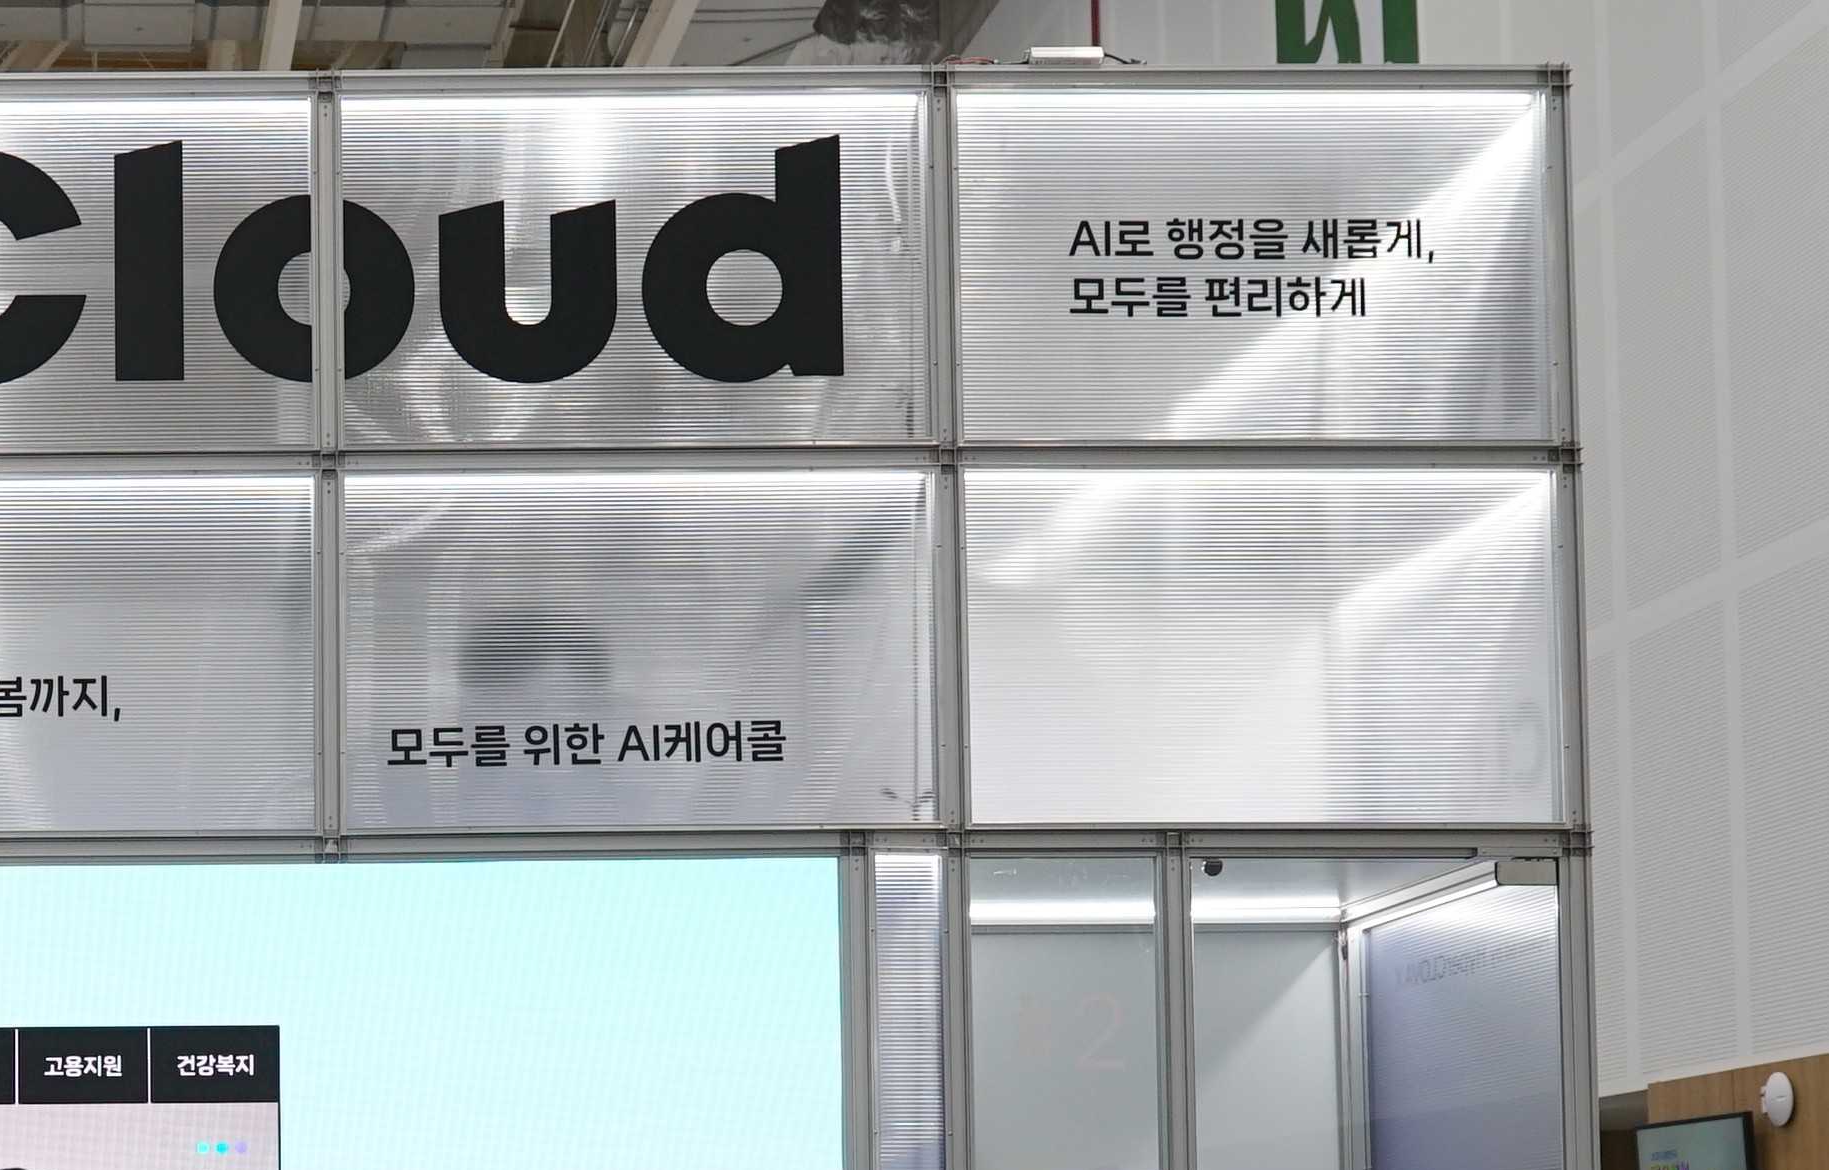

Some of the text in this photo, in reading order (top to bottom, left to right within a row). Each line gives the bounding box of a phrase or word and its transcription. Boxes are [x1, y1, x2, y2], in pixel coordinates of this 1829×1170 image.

[1069, 217, 1434, 263] AI로 행정을 새롭게,
[1069, 276, 1366, 318] 모두를 편리하게
[387, 719, 787, 768] 모두를 위한 AI케어콜
[43, 1054, 123, 1078] 고용지원
[176, 1054, 255, 1078] 건강복지
